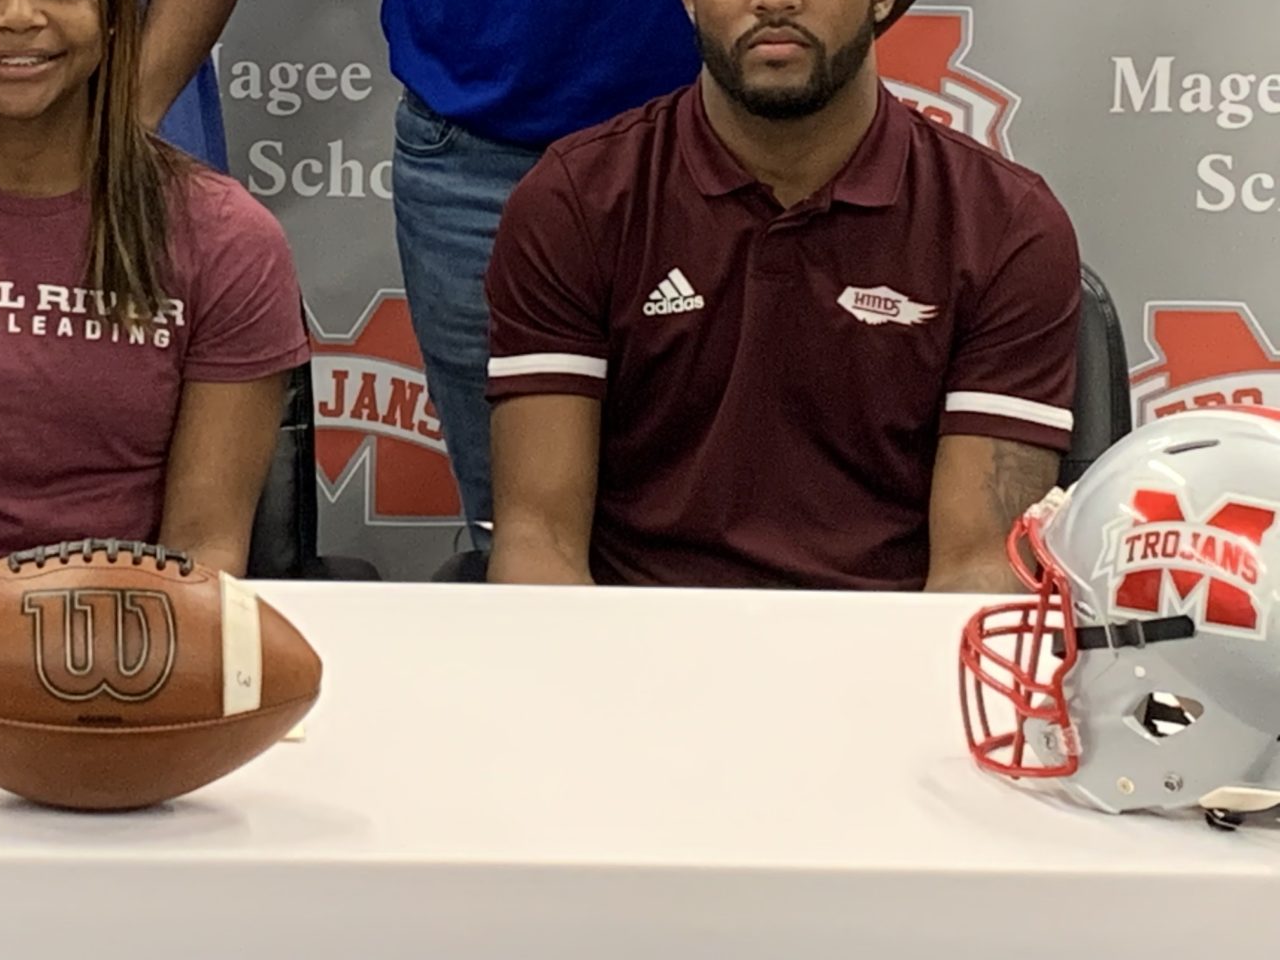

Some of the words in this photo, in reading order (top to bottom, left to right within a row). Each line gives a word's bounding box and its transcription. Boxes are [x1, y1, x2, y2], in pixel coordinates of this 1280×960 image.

[211, 43, 373, 115] agee
[642, 294, 705, 317] adidas
[1124, 527, 1259, 586] TROJANS
